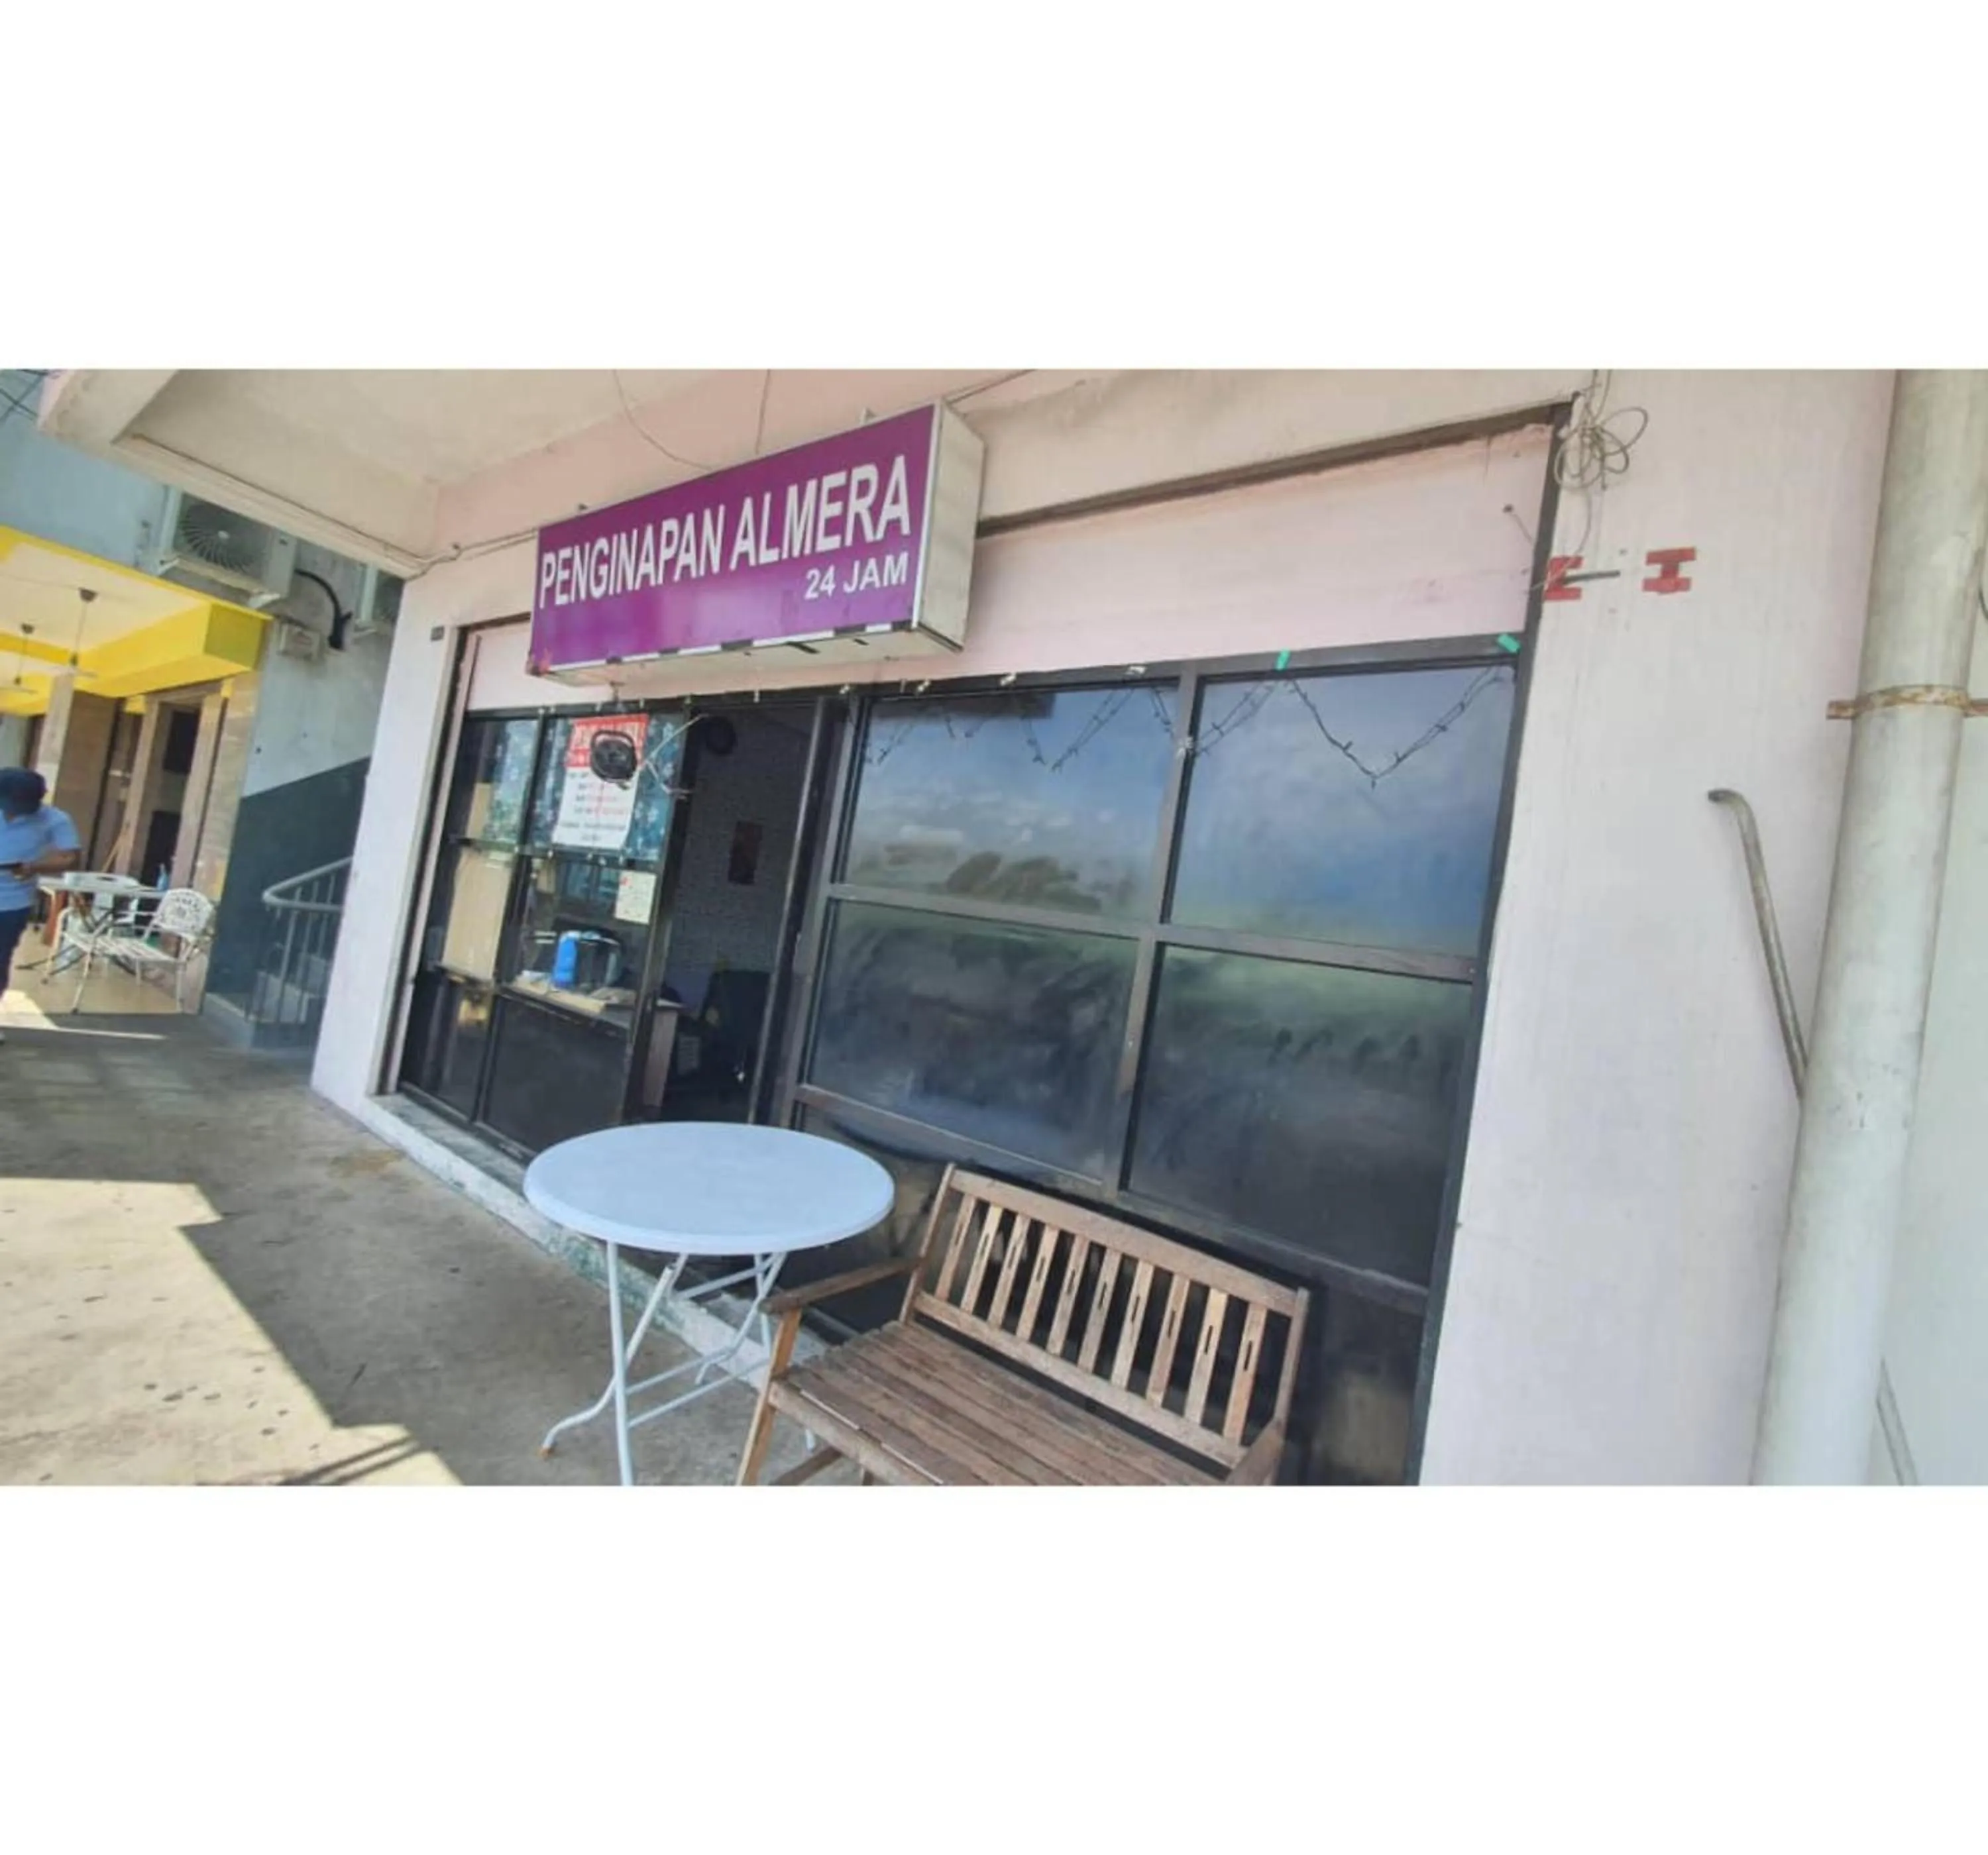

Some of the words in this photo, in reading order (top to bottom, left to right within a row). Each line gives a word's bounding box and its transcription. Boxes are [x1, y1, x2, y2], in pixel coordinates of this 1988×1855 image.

[539, 504, 725, 609] PENGINAPAN
[730, 454, 911, 571] ALMERA
[804, 567, 835, 600] 24
[844, 552, 909, 594] JAM
